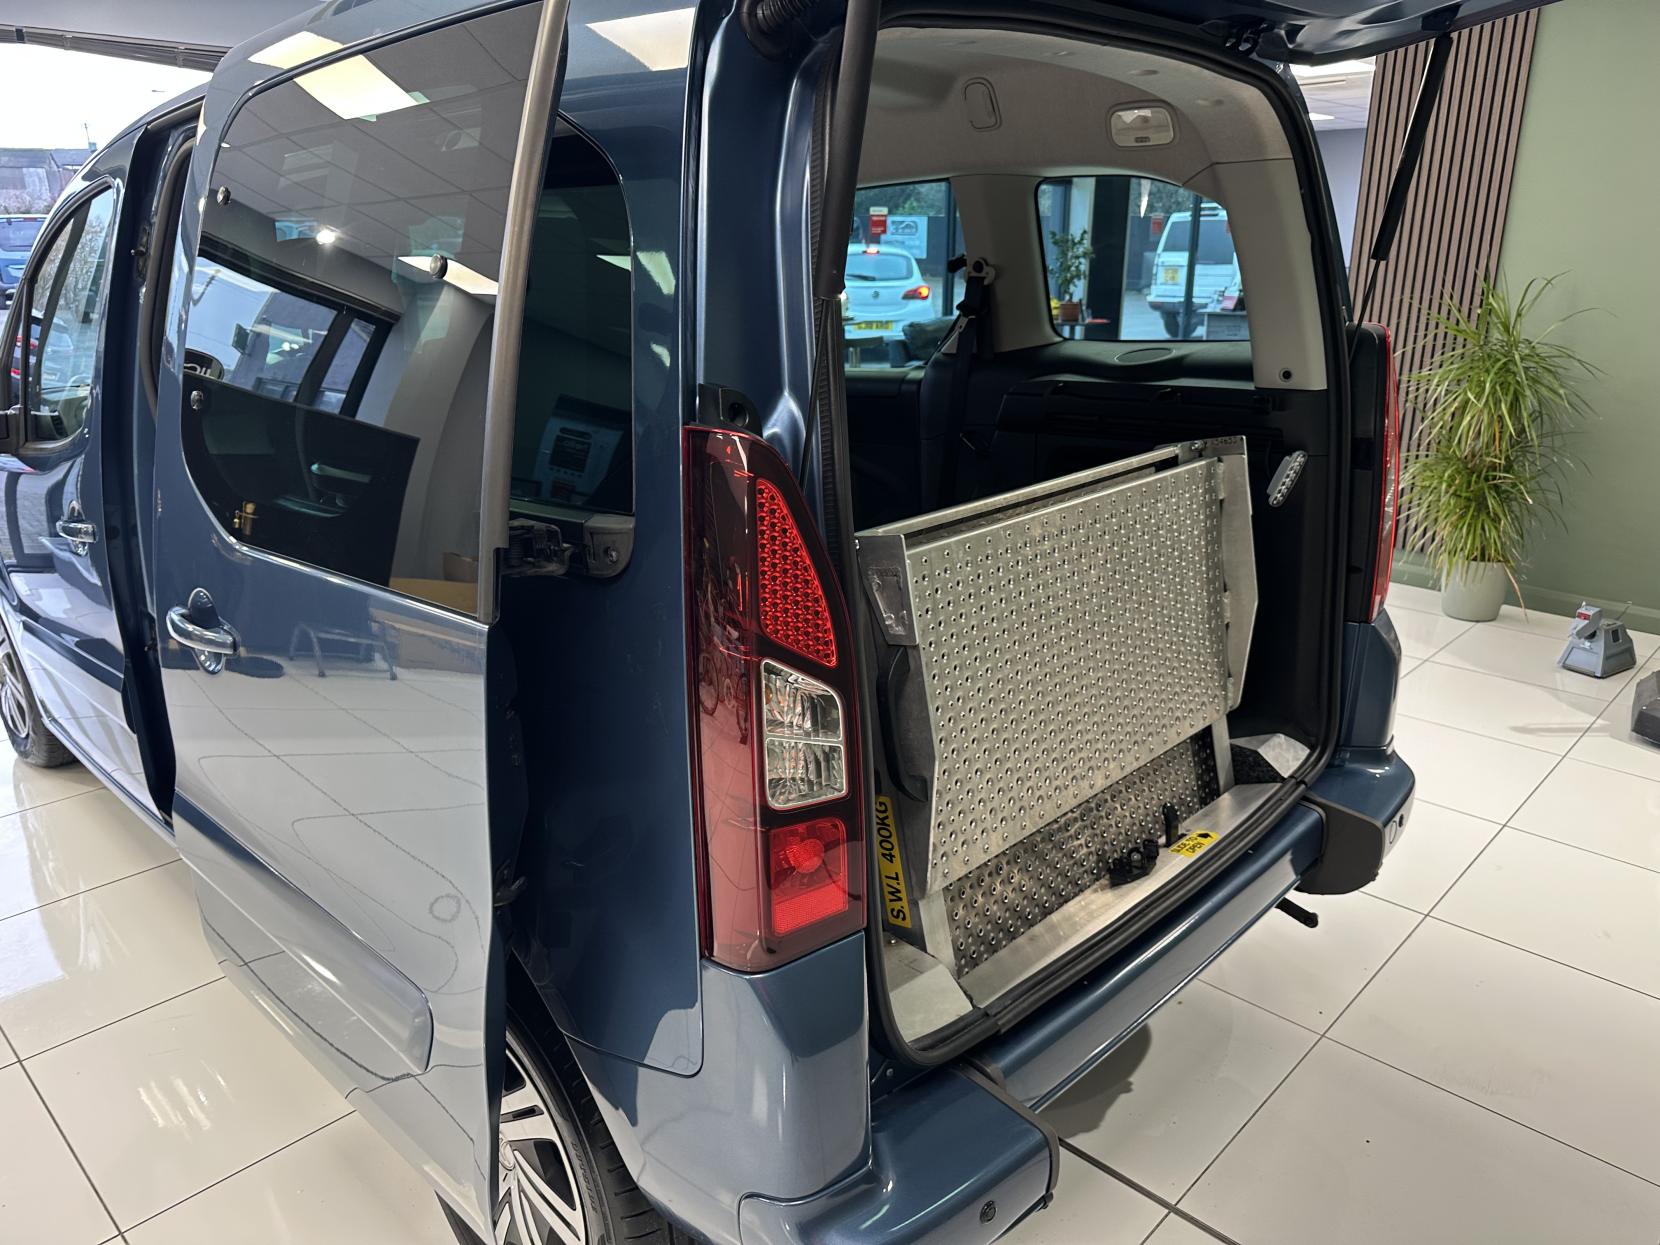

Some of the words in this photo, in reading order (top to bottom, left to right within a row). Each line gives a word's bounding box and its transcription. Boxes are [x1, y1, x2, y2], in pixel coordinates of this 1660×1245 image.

[876, 801, 895, 864] 400KG
[1186, 842, 1205, 853] OPEN
[885, 872, 907, 921] S.W.L
